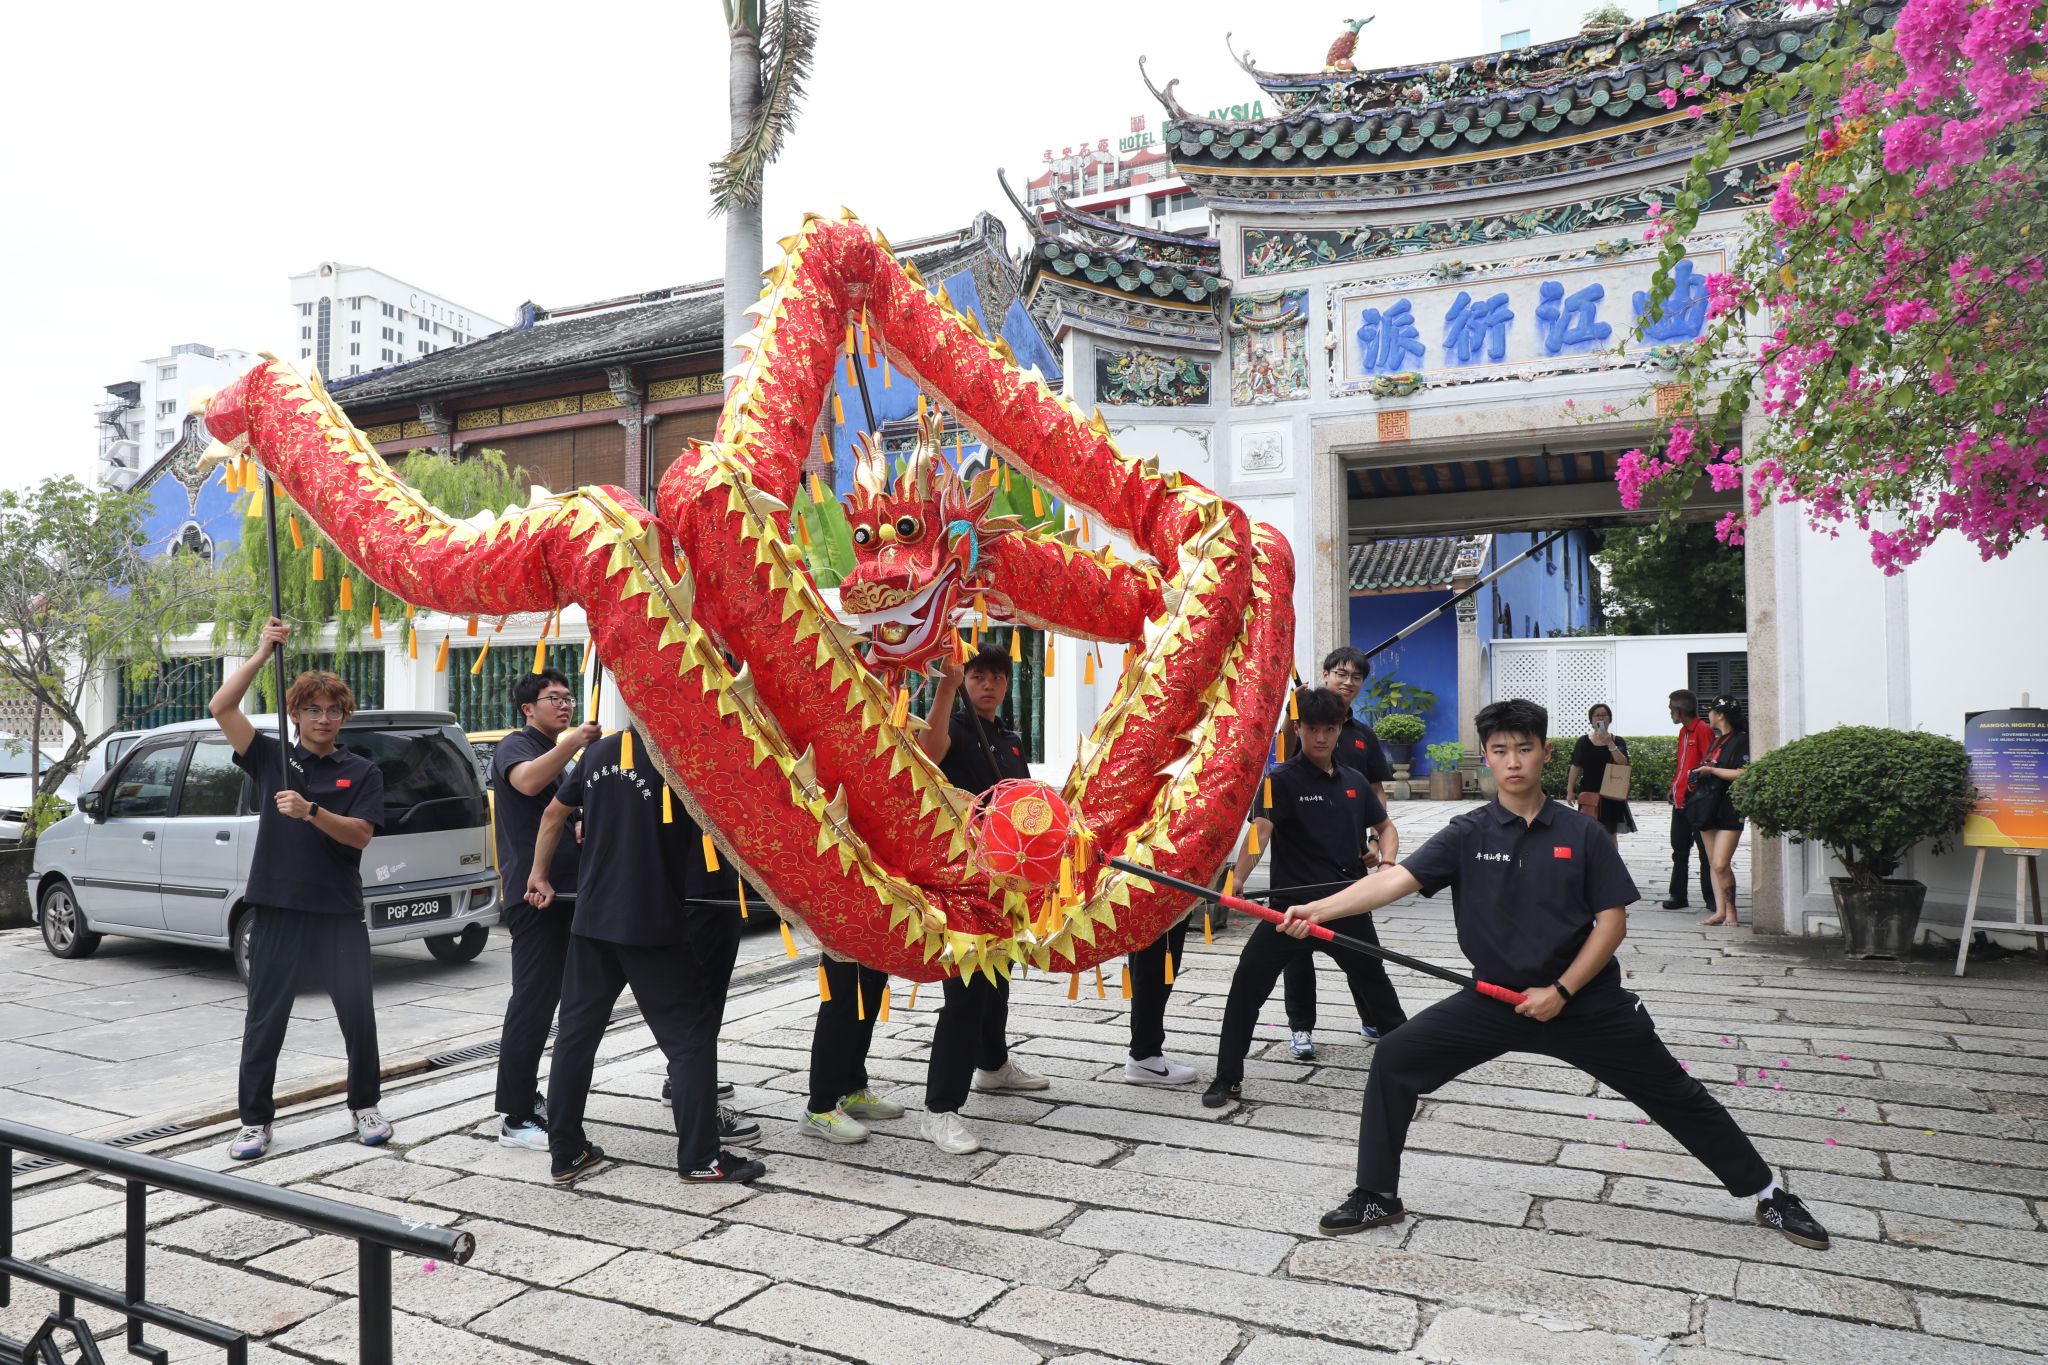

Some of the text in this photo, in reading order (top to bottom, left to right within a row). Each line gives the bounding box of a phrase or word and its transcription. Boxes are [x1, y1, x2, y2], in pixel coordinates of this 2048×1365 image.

[1119, 132, 1156, 151] HOTEL
[409, 293, 472, 332] CITITEL
[387, 900, 440, 920] PGP 2209
